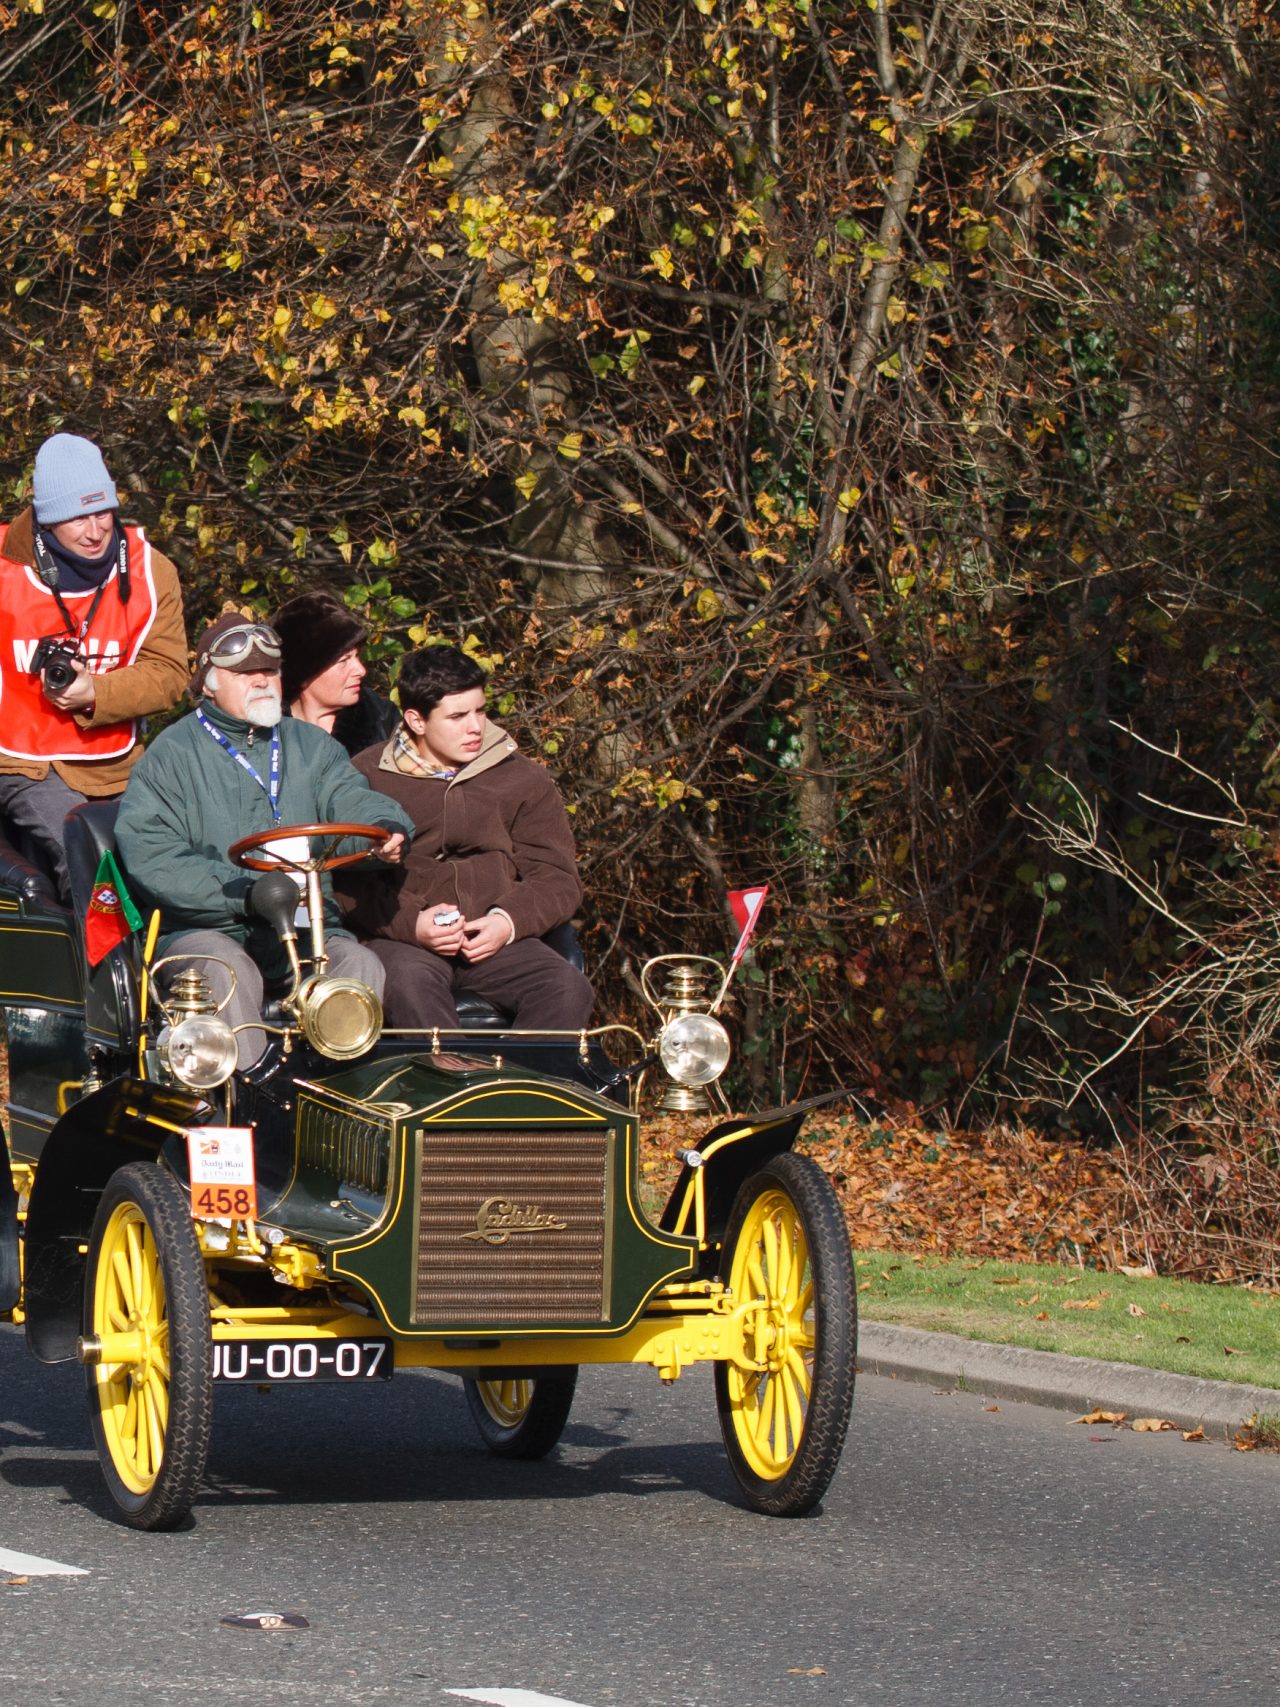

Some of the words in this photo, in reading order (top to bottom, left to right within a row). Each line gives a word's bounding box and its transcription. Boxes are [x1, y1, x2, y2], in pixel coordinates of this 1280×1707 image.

[12, 637, 121, 674] MIA
[197, 1188, 251, 1215] 458
[460, 1196, 567, 1245] Cadillac
